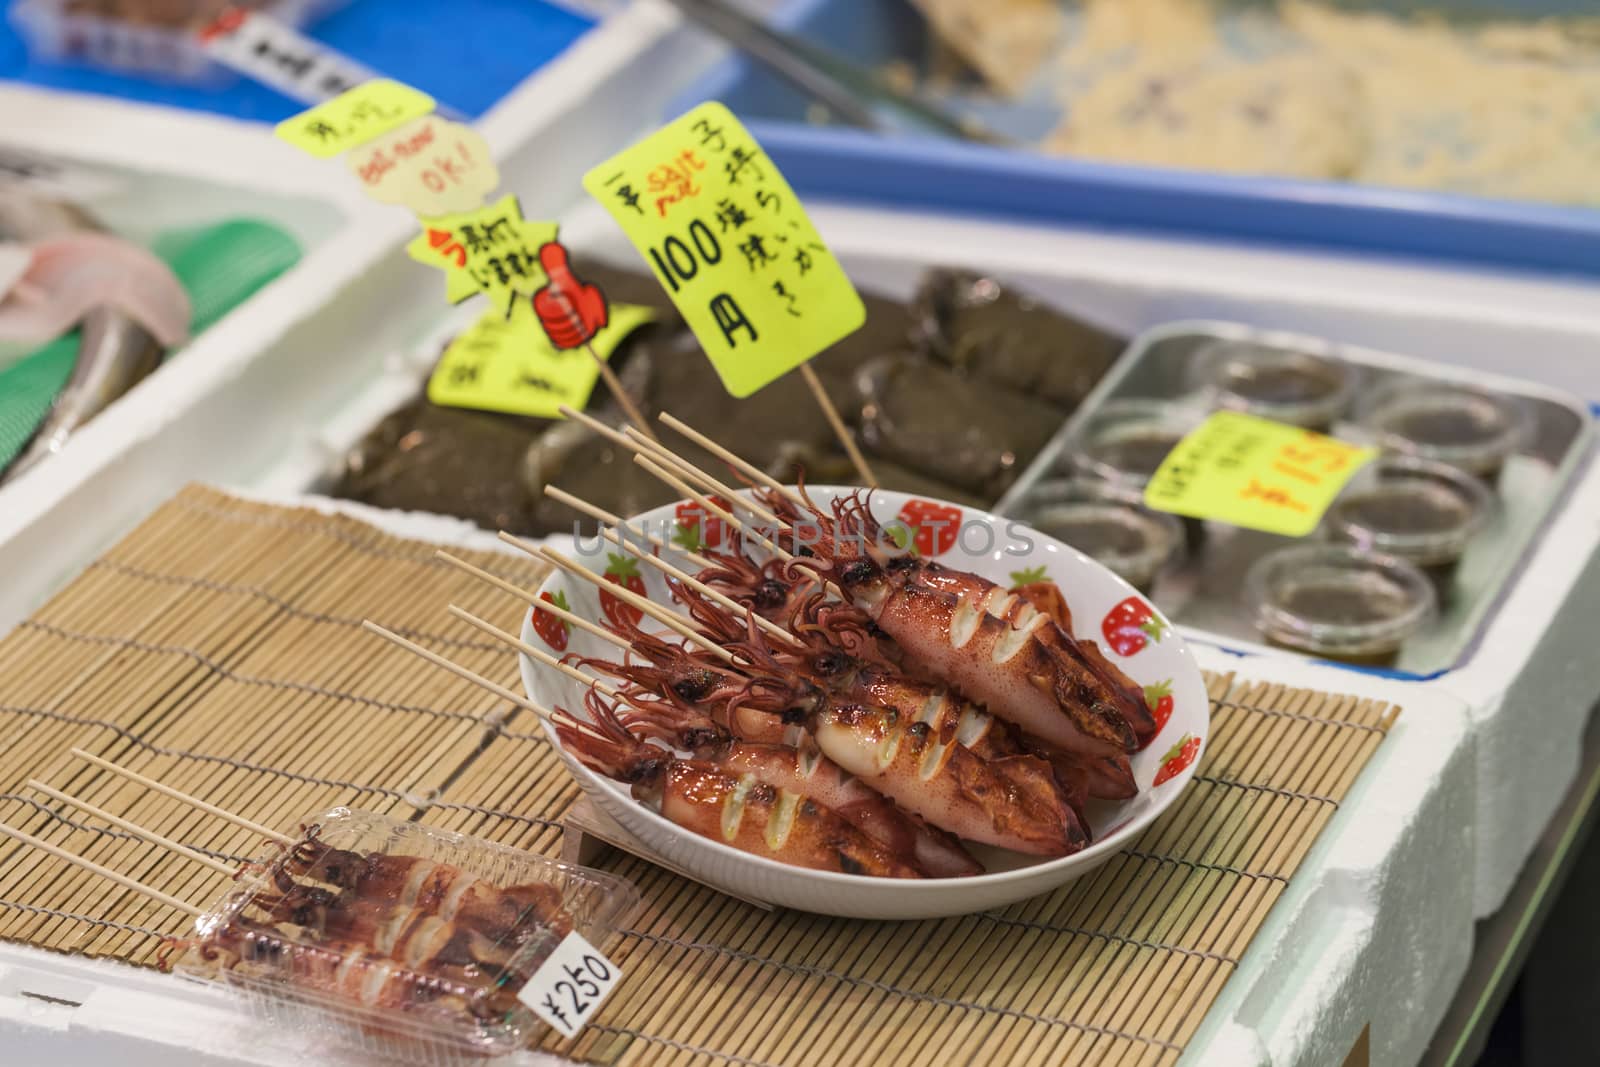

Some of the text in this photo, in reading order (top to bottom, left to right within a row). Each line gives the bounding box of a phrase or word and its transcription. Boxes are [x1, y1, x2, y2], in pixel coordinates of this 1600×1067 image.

[649, 219, 722, 292] 100
[709, 292, 758, 348] 円
[542, 955, 610, 1030] ¥250
